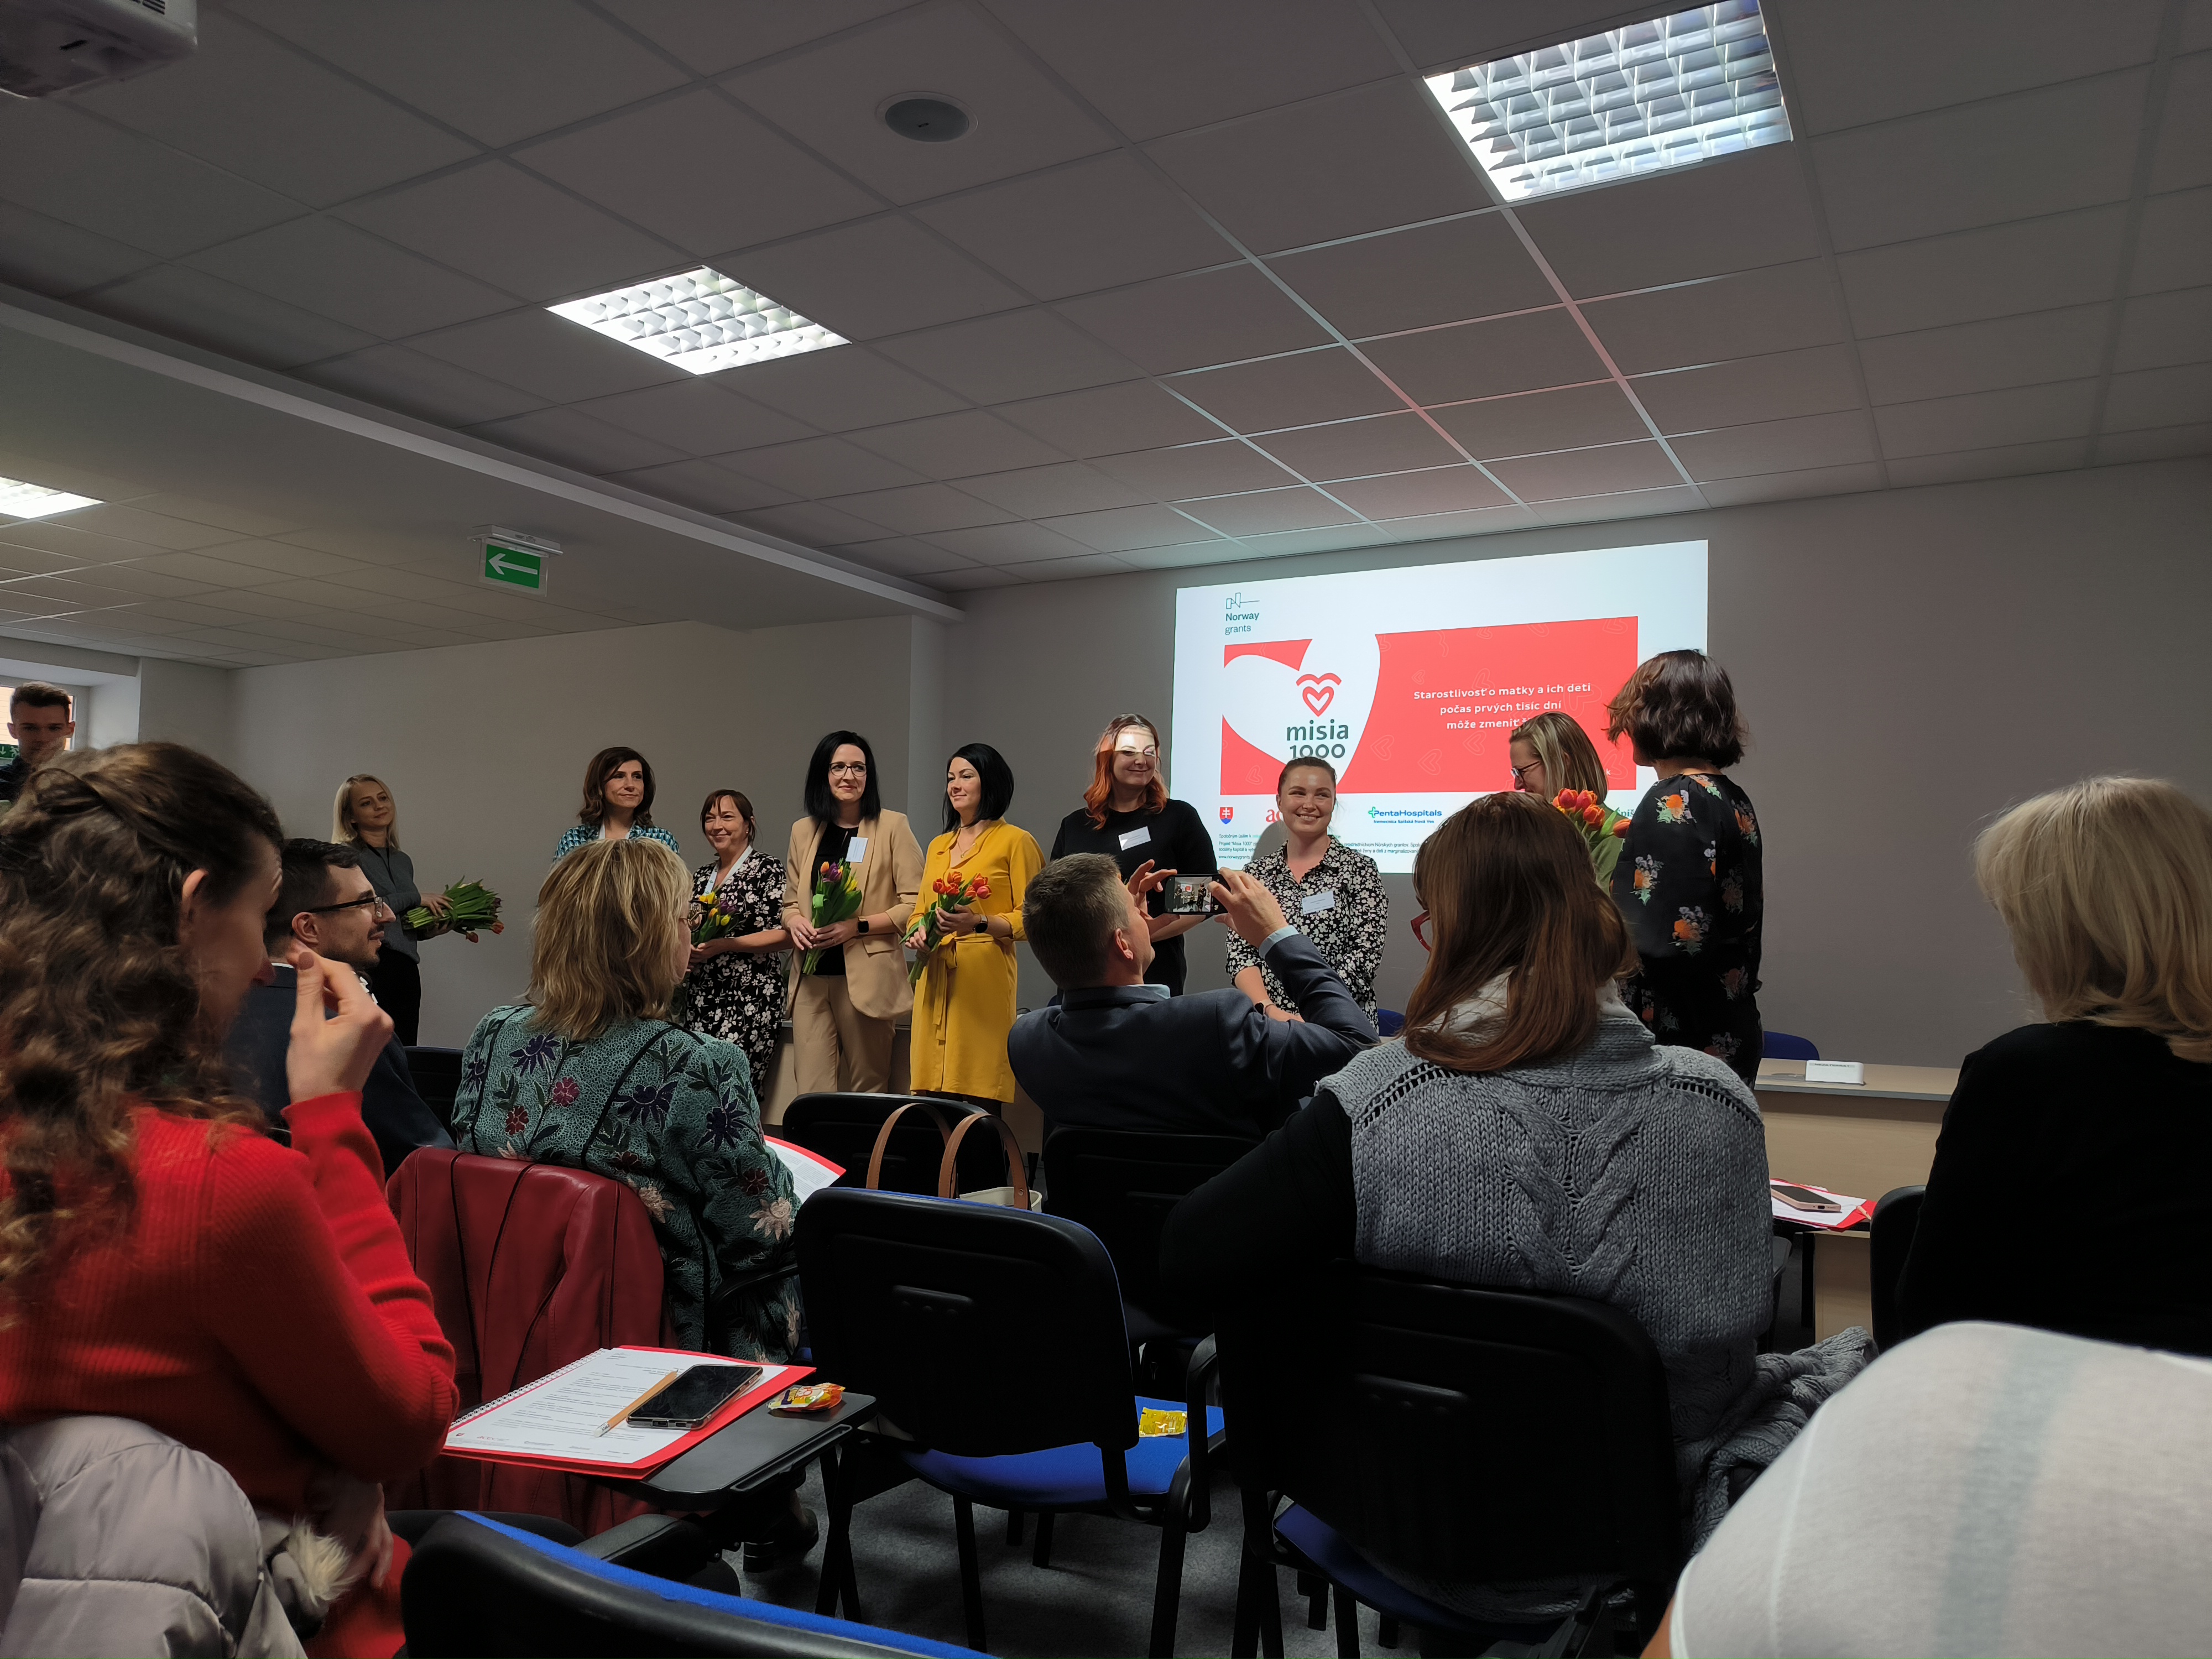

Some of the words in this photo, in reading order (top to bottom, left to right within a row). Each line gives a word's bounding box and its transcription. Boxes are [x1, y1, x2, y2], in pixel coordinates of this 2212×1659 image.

[1225, 613, 1260, 622] Norway
[1225, 625, 1251, 635] grants
[1413, 688, 1488, 700] Starostlivosť
[1499, 686, 1535, 696] matky
[1547, 685, 1564, 693] ich
[1567, 682, 1591, 692] deti
[1440, 705, 1472, 716] počas
[1474, 703, 1512, 714] prvých
[1516, 701, 1540, 711] tisíc
[1543, 700, 1562, 710] dní
[1286, 719, 1349, 741] misia
[1447, 720, 1477, 729] môže
[1479, 718, 1520, 729] zmeniť
[1290, 743, 1345, 759] 1000
[1374, 810, 1442, 818] PentaHospitals
